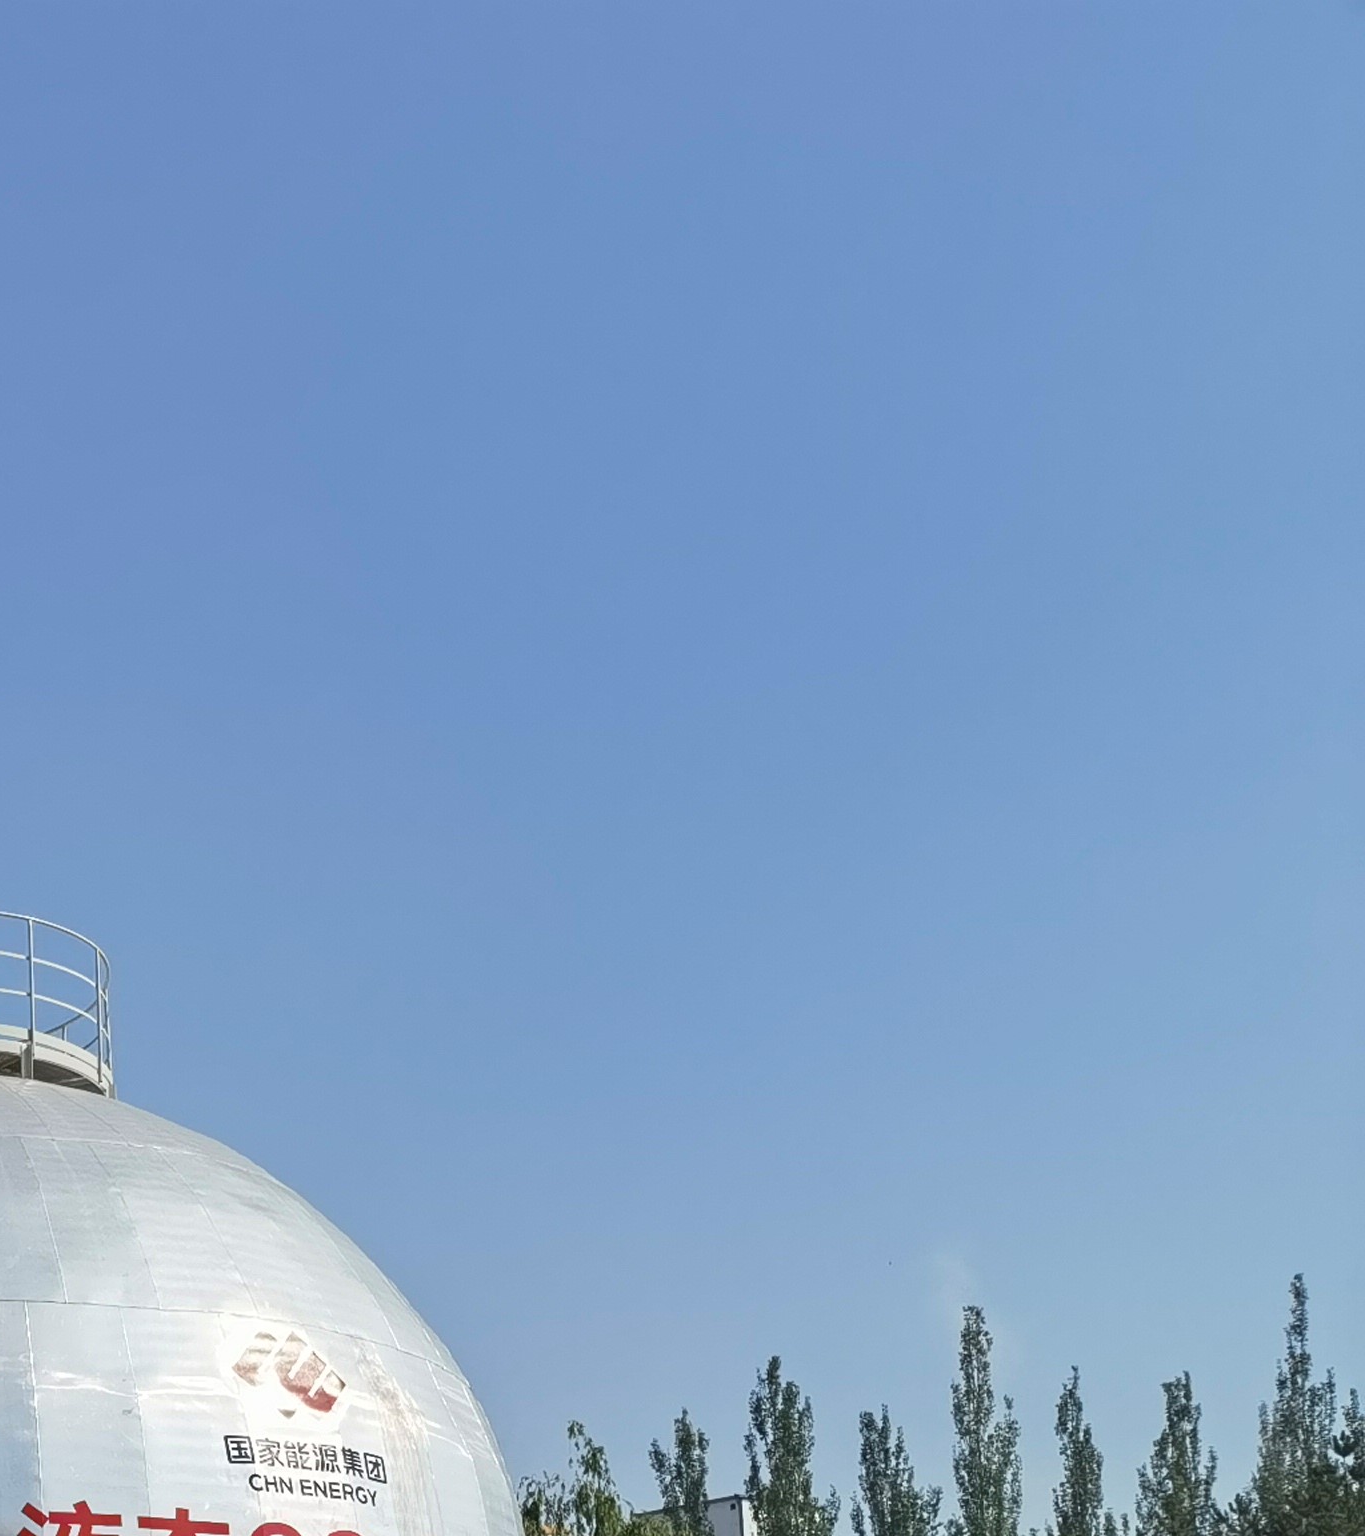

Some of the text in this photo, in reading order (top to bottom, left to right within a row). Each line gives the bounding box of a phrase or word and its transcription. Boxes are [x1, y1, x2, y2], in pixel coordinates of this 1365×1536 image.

[223, 1435, 387, 1484] 国家能源集团
[248, 1474, 377, 1507] CHN ENERGY
